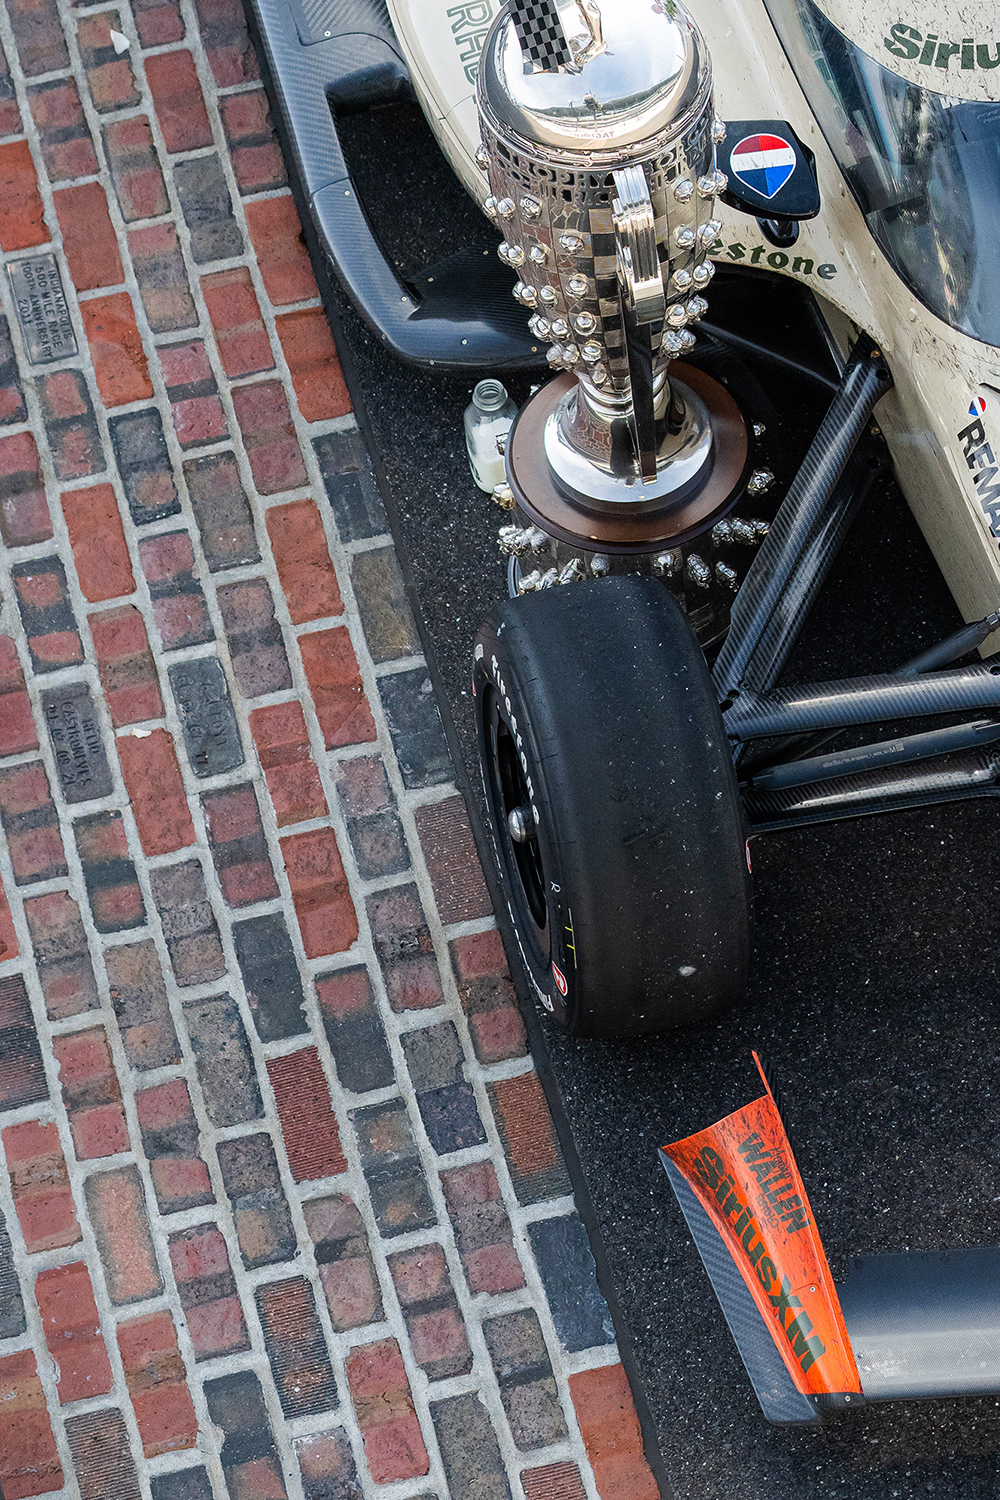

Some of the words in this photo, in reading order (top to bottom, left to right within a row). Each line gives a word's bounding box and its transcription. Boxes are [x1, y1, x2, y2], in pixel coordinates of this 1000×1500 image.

[35, 266, 48, 288] 500
[706, 240, 838, 282] estone
[18, 298, 32, 326] 2011
[41, 291, 56, 317] MILE
[47, 269, 73, 340] INDIANAPOLIS
[29, 294, 54, 359] ANNIVERSARY
[48, 320, 64, 349] RACE
[62, 701, 93, 787] CASTRONEVES
[736, 1131, 813, 1235] WALLEN
[755, 1192, 780, 1231] RADIO
[692, 1145, 826, 1375] SiriusXM
